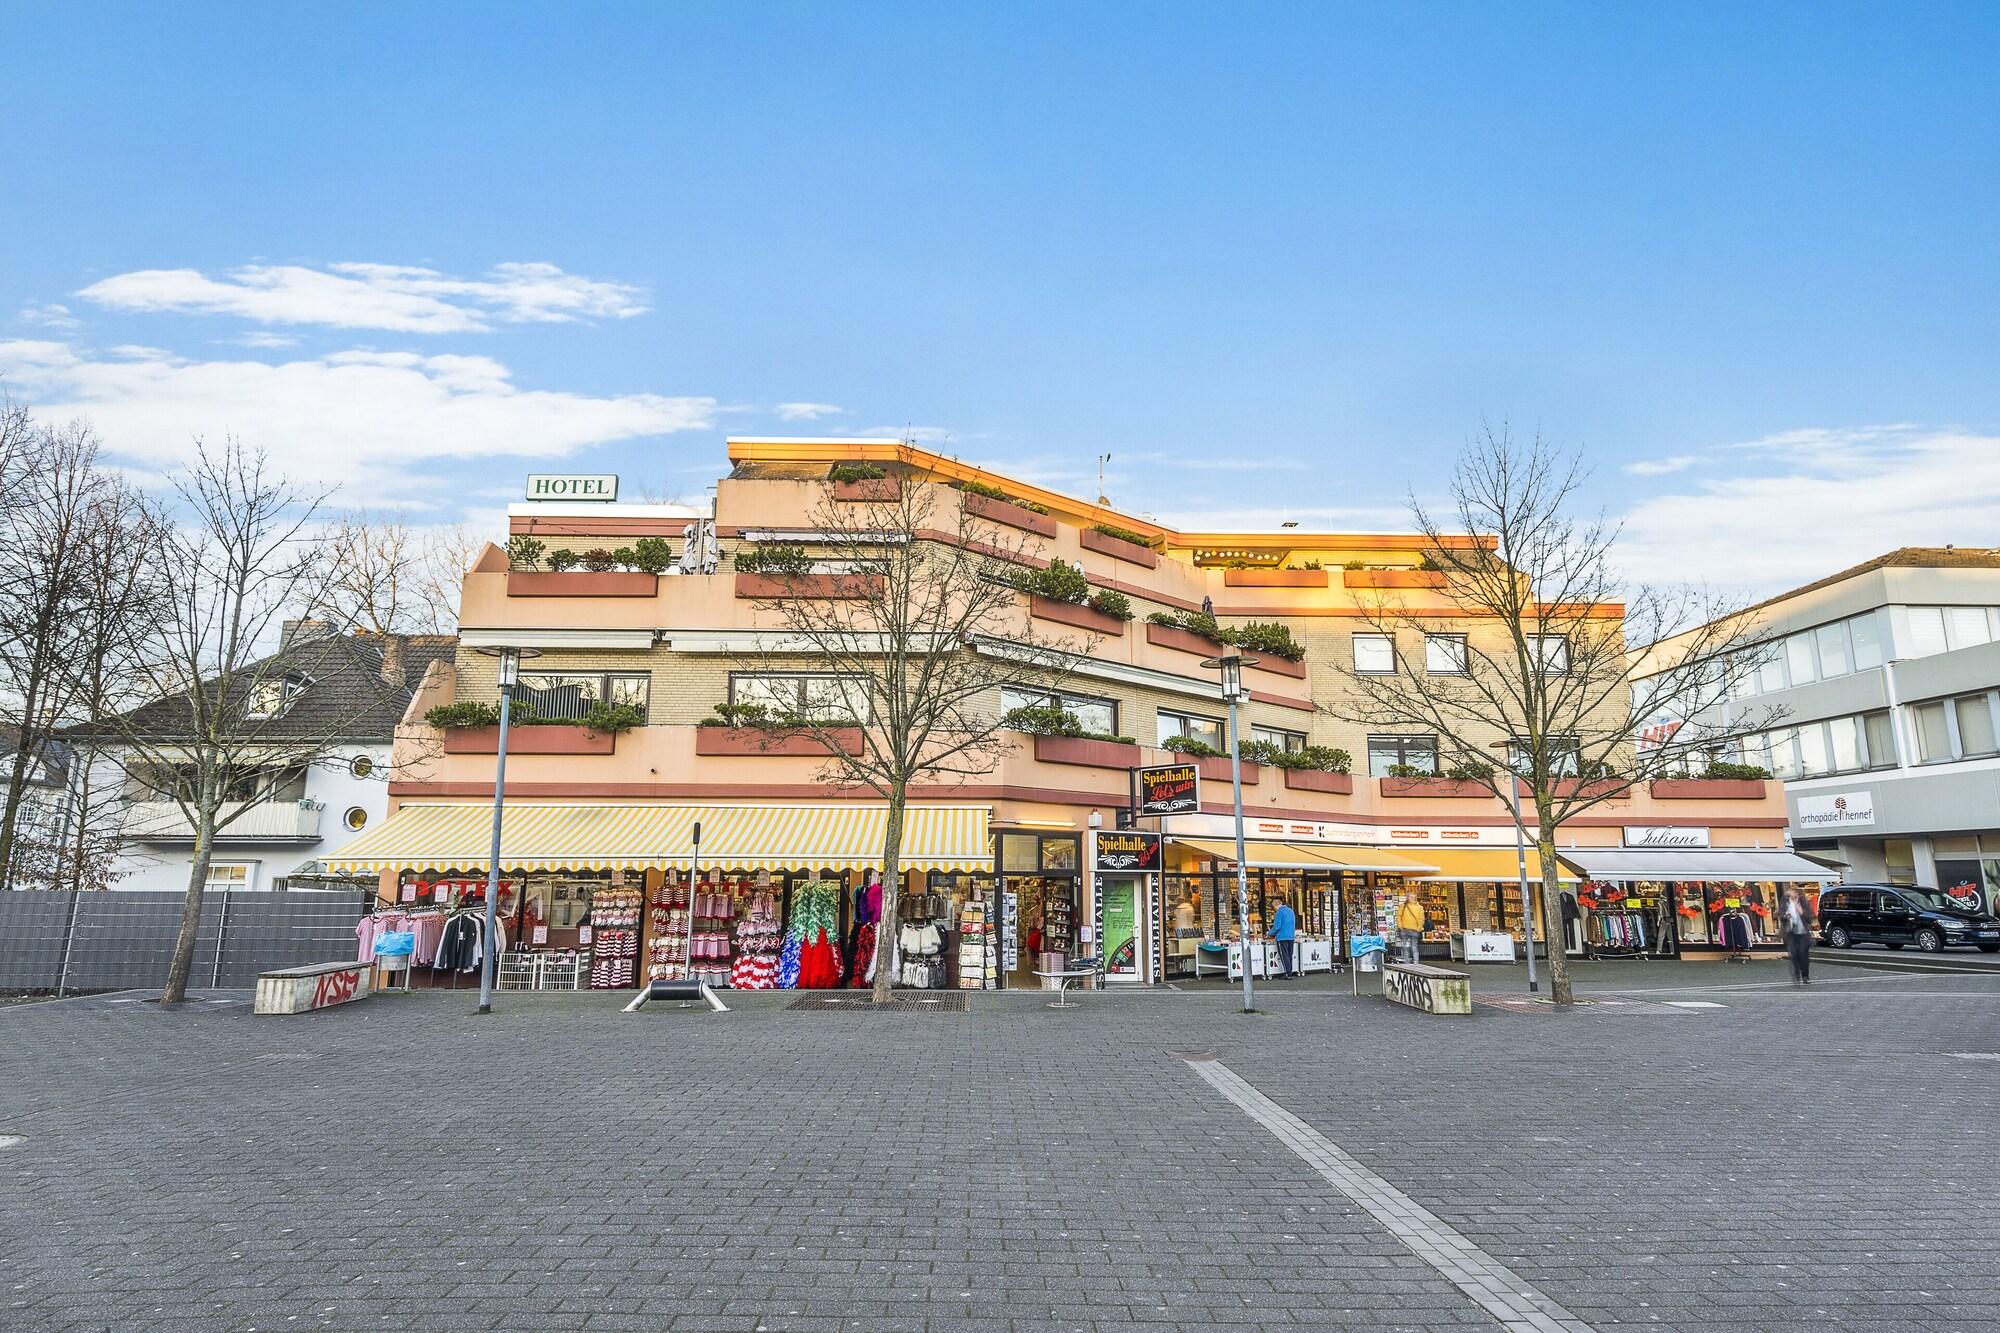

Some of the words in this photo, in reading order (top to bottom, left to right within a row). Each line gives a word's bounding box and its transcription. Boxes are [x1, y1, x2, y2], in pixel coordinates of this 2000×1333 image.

[536, 479, 609, 494] HOTEL
[1641, 721, 1682, 750] HIT
[1143, 768, 1195, 787] Spielhalle
[1800, 811, 1838, 825] orthopädie
[1845, 808, 1872, 820] hennef
[1098, 835, 1146, 855] Spielhalle
[1639, 826, 1699, 845] Juliane
[1948, 883, 1977, 898] HIT
[1152, 877, 1160, 978] SPIELHALLE
